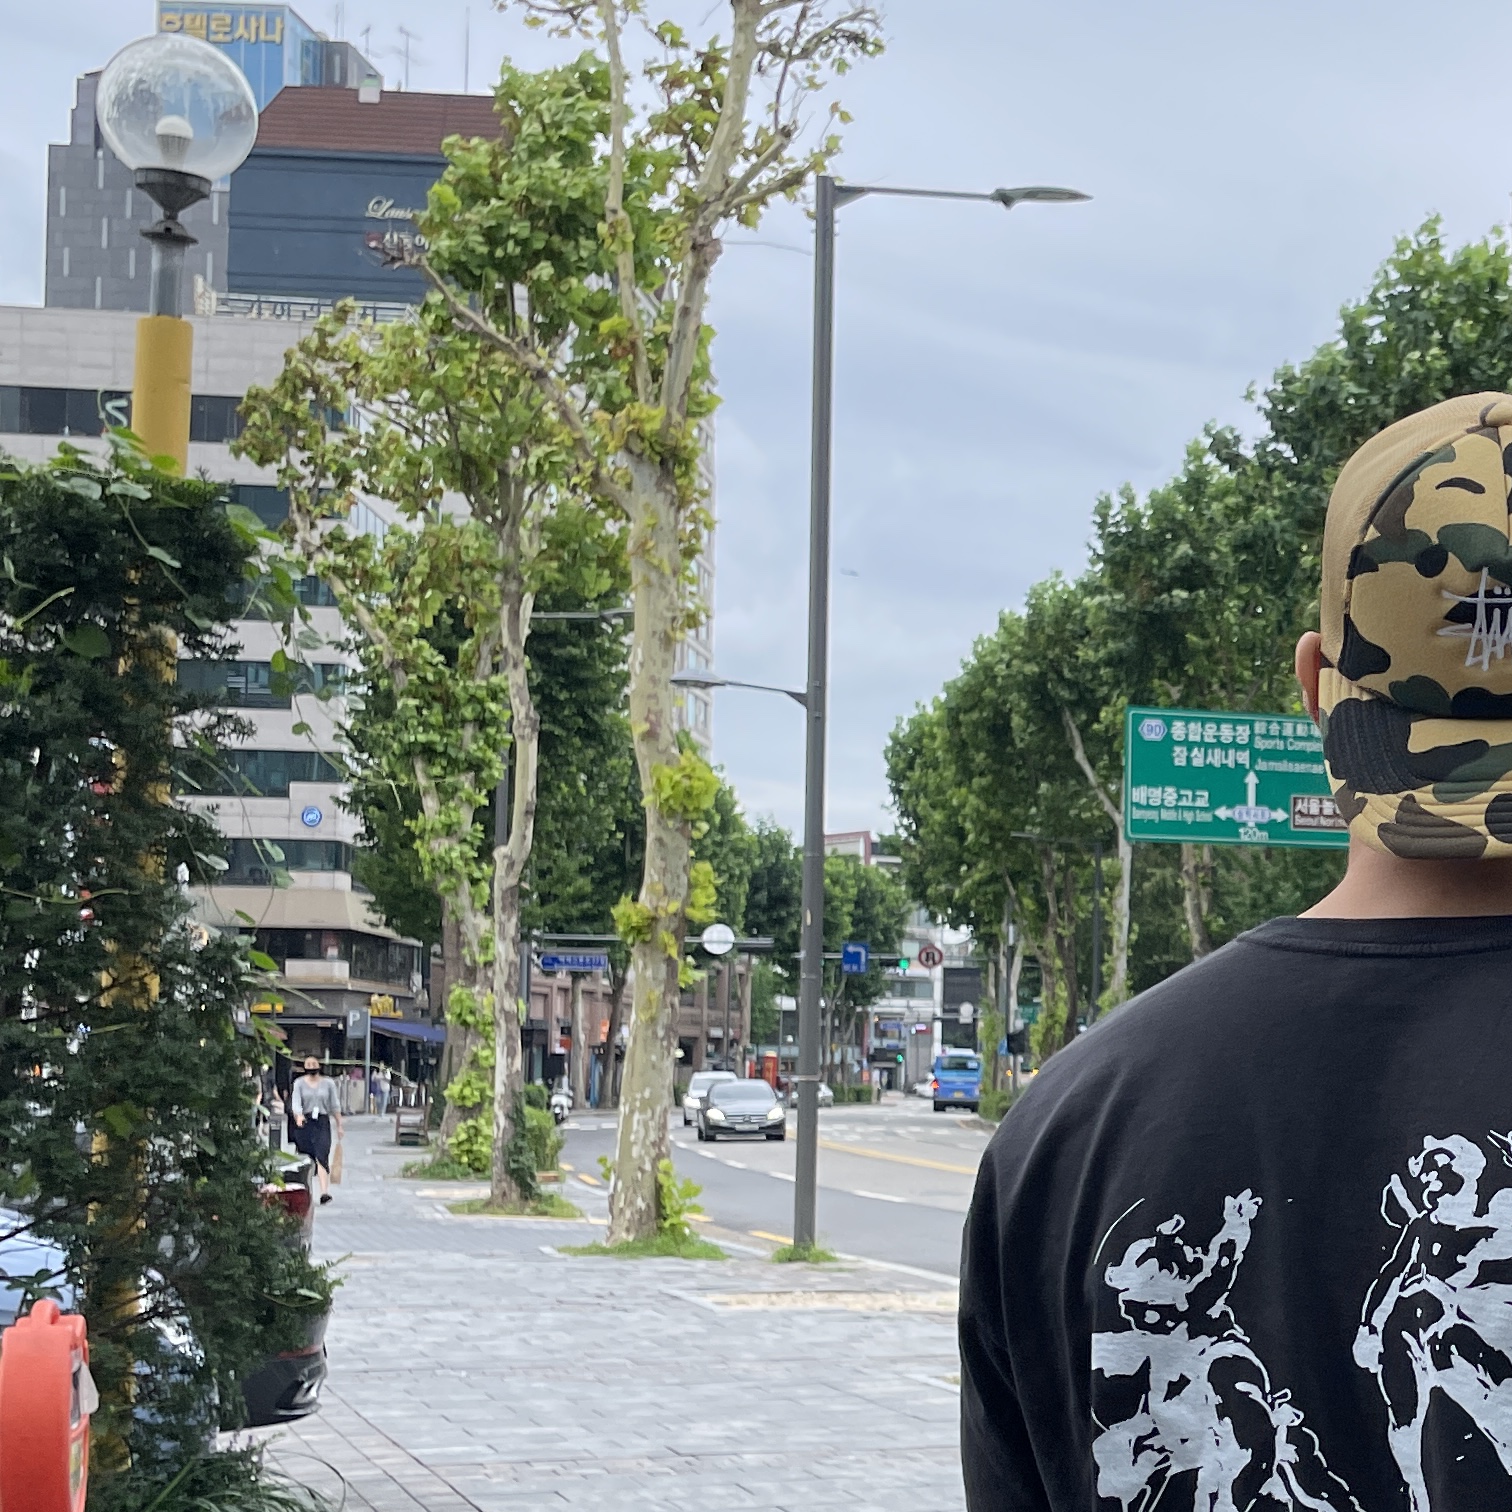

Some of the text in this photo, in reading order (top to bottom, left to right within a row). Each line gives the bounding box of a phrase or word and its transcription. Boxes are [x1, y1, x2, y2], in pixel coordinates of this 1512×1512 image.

[1171, 721, 1251, 745] 종합운동장
[1173, 746, 1250, 770] 잠실새내역
[1239, 827, 1269, 841] 120m
